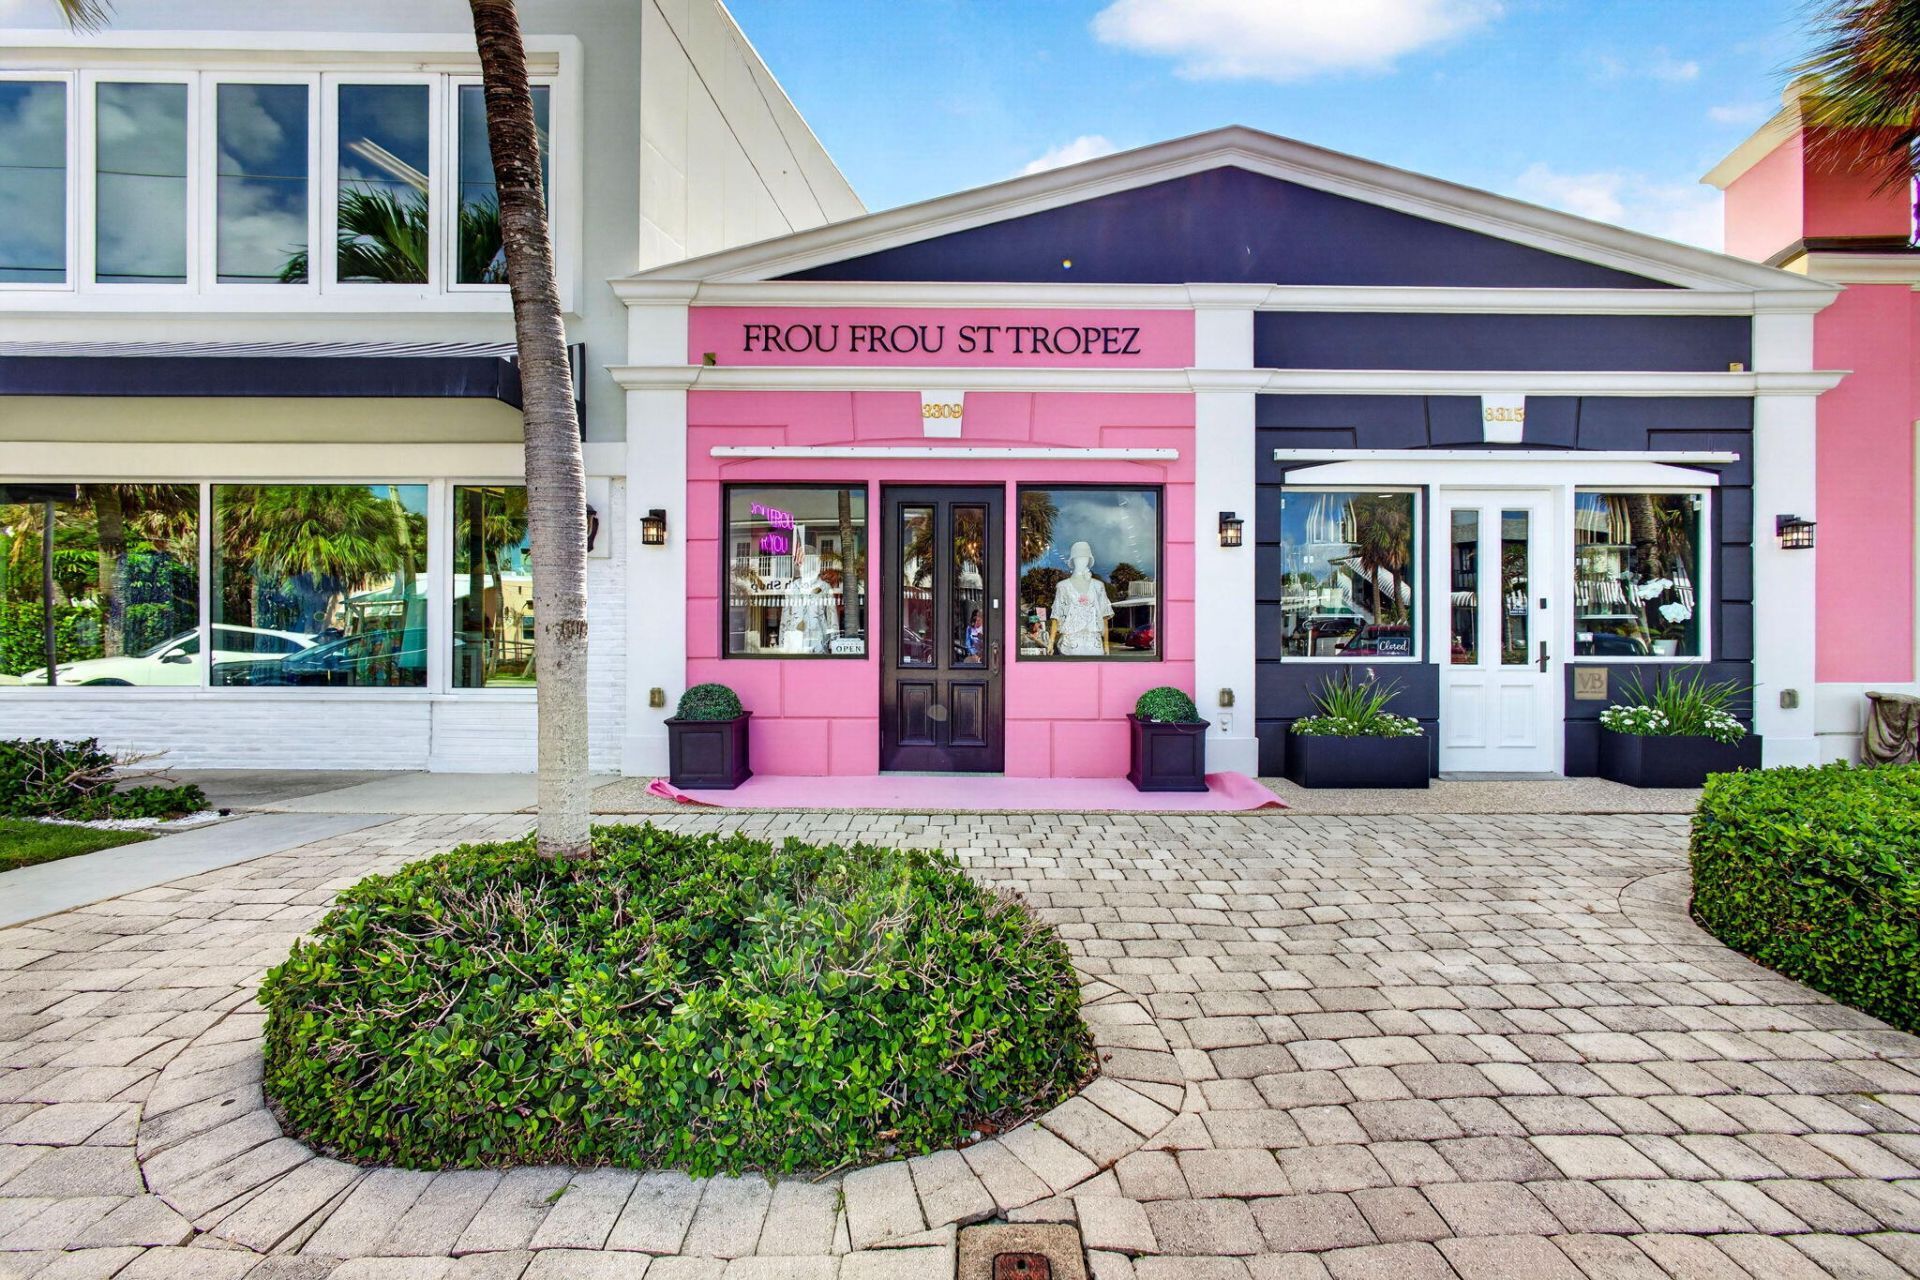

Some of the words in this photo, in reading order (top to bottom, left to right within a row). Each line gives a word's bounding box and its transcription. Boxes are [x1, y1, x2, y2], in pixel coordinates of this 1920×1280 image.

[743, 324, 839, 352] FROU
[849, 325, 944, 353] FROU
[958, 325, 1000, 353] ST
[1006, 326, 1141, 355] TROPEZ
[922, 403, 963, 419] 3309
[836, 645, 861, 653] OPEN
[1379, 640, 1408, 651] Closed
[1578, 672, 1604, 690] VB
